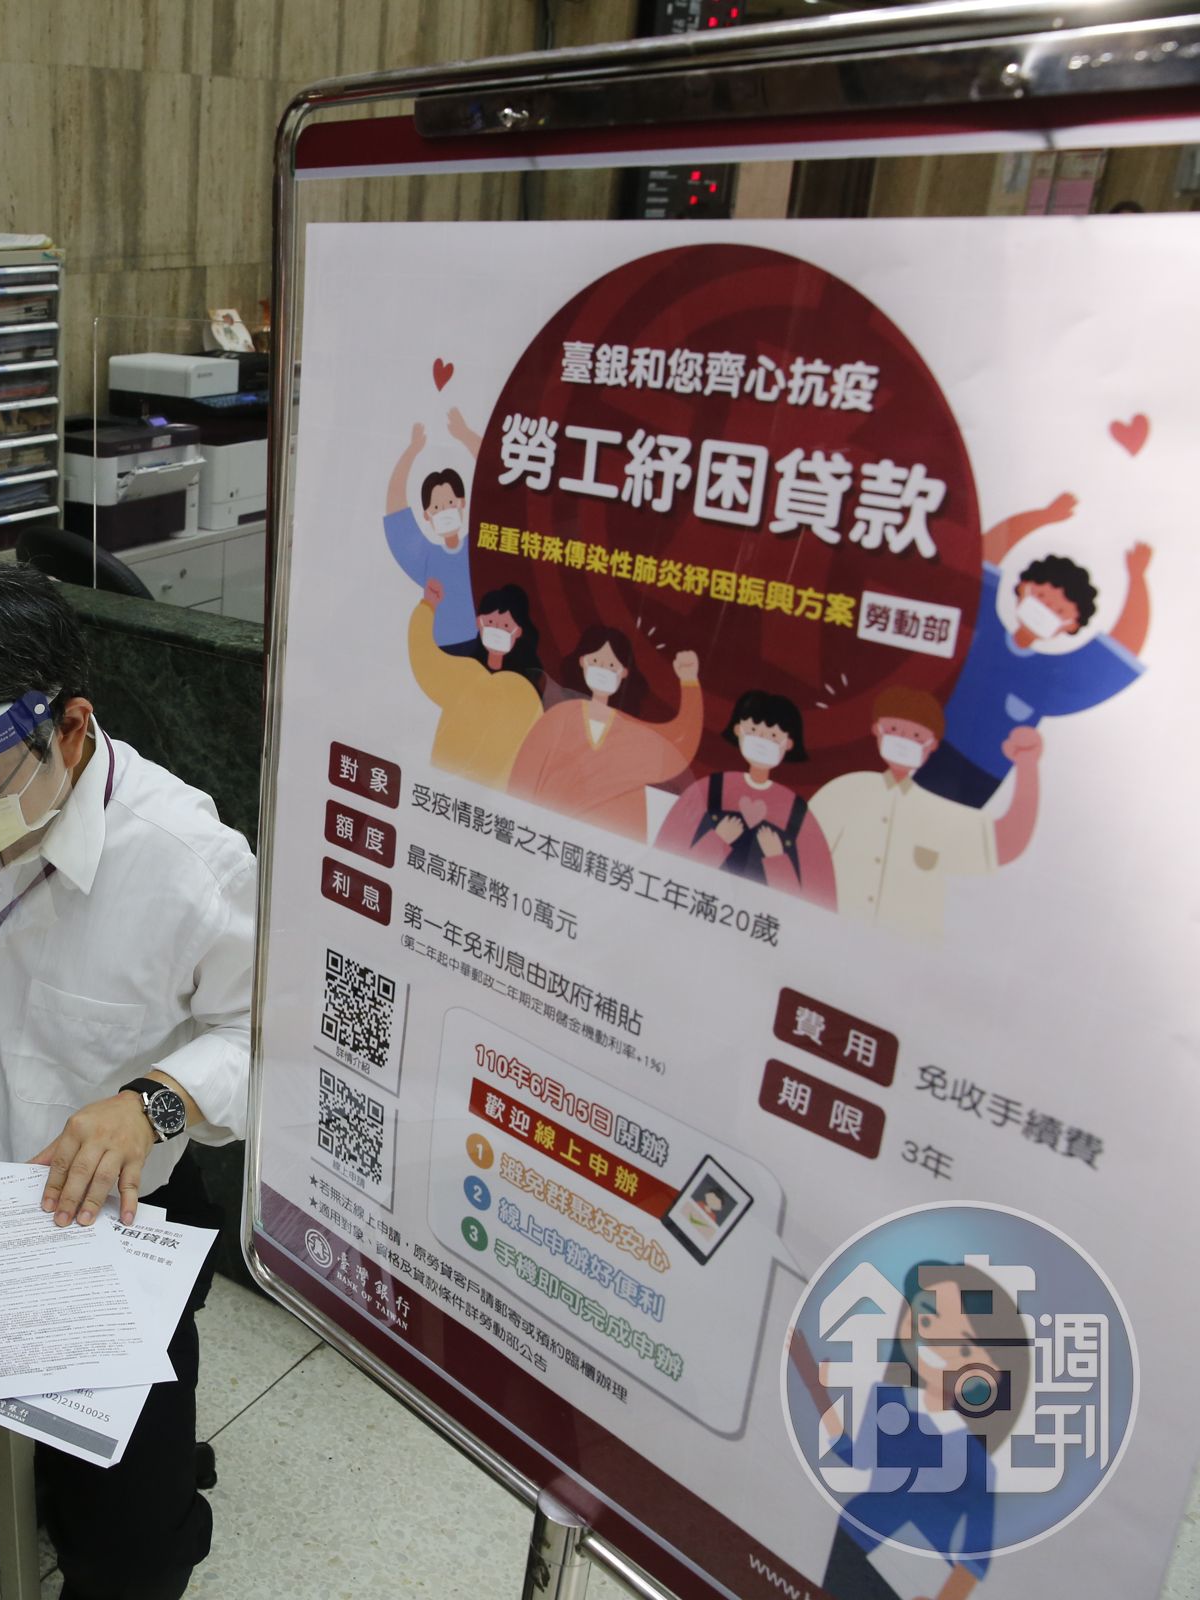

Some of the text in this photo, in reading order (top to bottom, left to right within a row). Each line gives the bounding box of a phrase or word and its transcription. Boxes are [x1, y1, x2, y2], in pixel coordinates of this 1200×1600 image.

[560, 340, 879, 414] 臺銀和您齊心抗疫
[498, 413, 948, 559] 勞工紓困貸款
[477, 522, 950, 646] 嚴重特殊傳染性肺炎紓困振興方案 勞動部
[335, 813, 579, 941] 額度 最高新臺幣10萬元
[339, 754, 781, 948] 對象 受疫情影響之本國籍勞工年滿20歲
[332, 869, 644, 1037] 利息 第一年免利息由政府補貼
[777, 1074, 953, 1182] 期限 3年
[792, 1005, 1105, 1171] 費用 免收手續費
[497, 1197, 666, 1323] 線上申辦好便利
[499, 1152, 671, 1274] 避免群聚好安心
[336, 1271, 409, 1331] BANK OF TAIWAN
[337, 1251, 410, 1318] 臺灣銀行
[494, 1238, 685, 1382] 手機即可完成申辦
